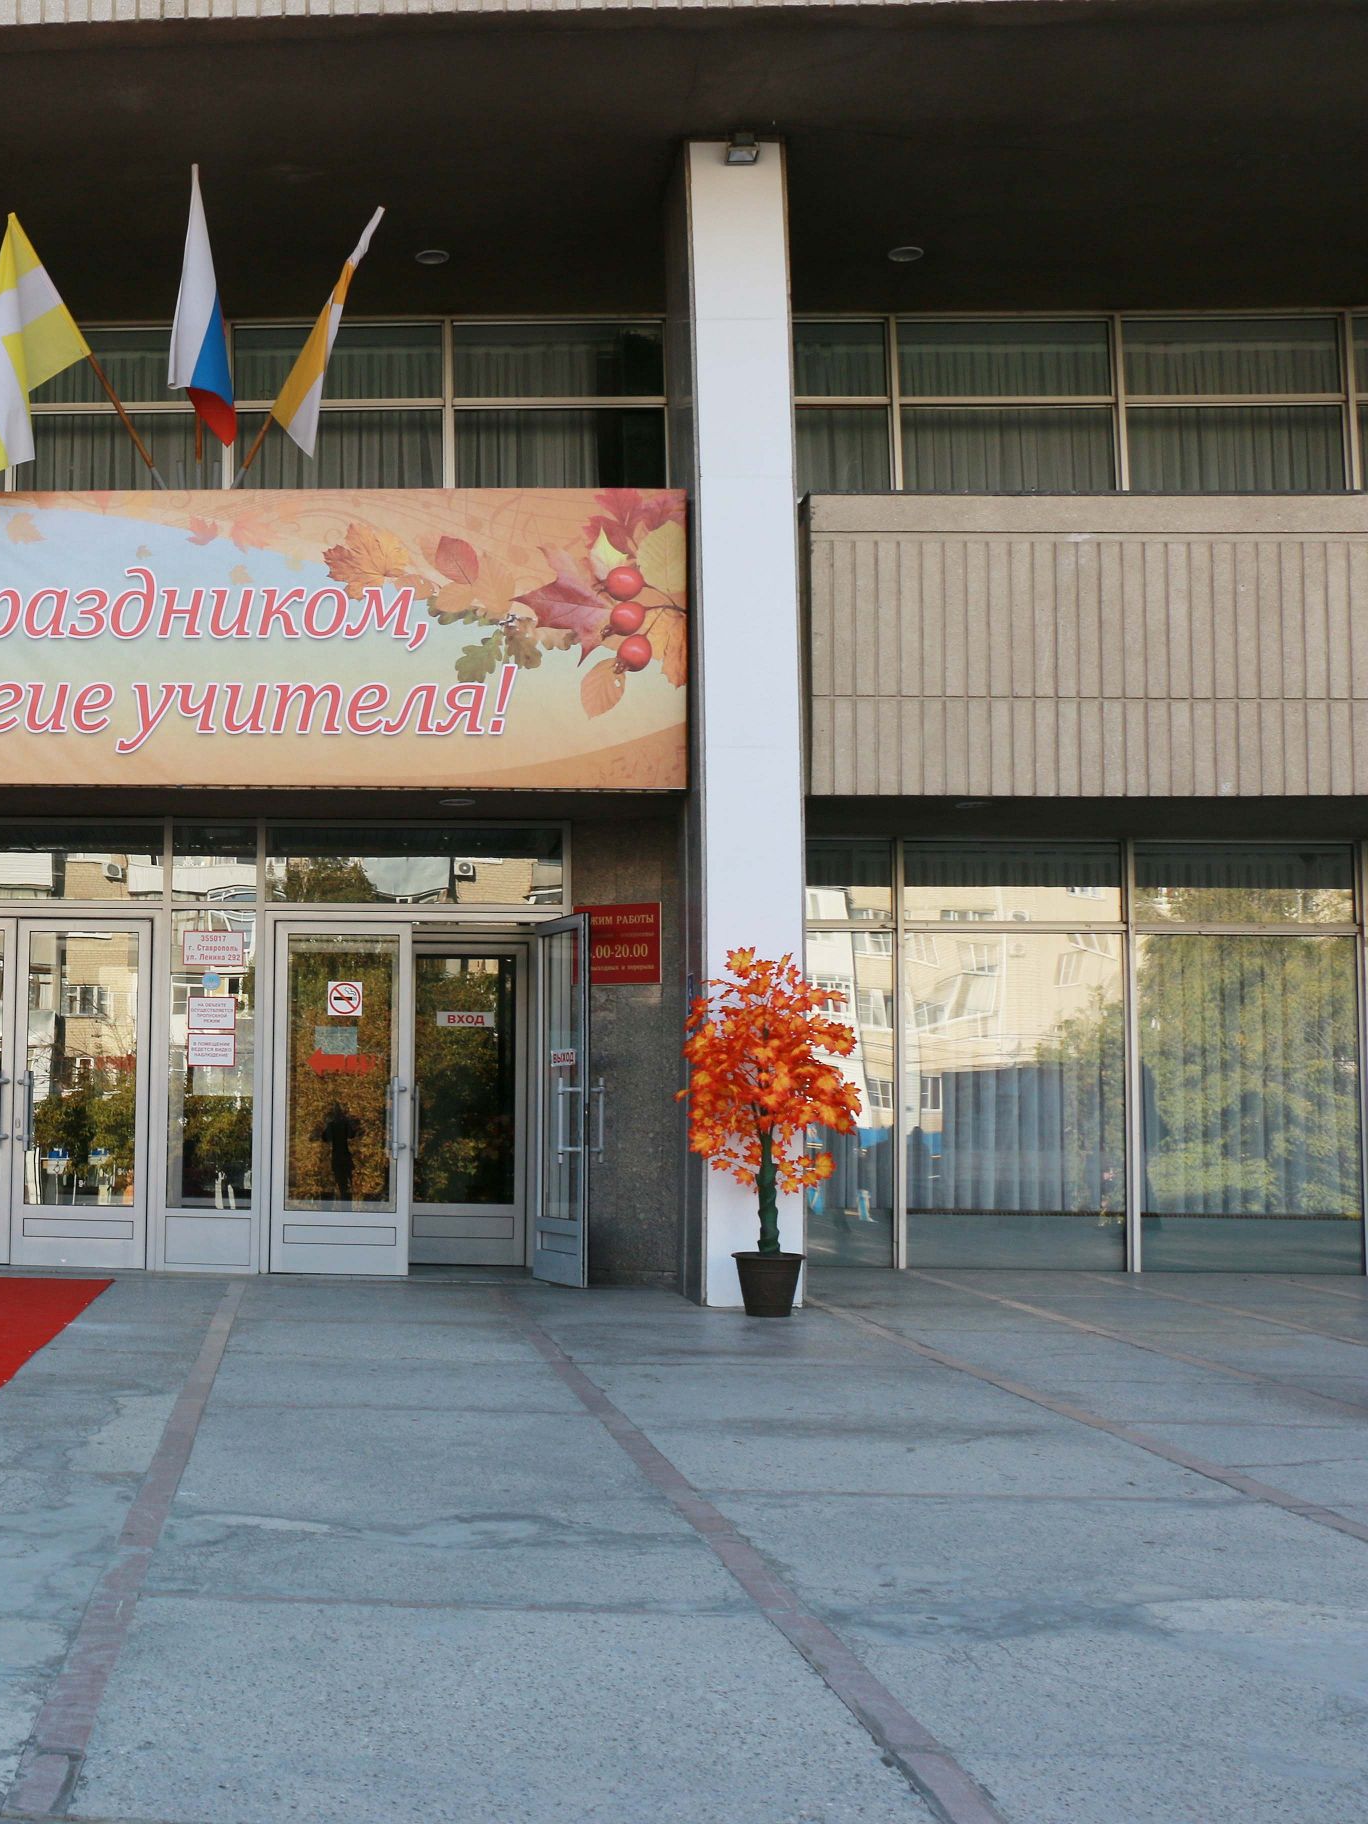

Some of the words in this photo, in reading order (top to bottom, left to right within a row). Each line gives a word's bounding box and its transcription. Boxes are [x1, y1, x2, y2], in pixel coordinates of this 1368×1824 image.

[116, 664, 518, 754] учителя!
[590, 916, 613, 926] ЖИМ
[616, 914, 655, 924] РАБОТЫ
[197, 944, 238, 952] Ставрополь
[591, 943, 649, 959] .00-20.00
[199, 953, 226, 961] Ленина
[227, 953, 241, 961] 292
[447, 1015, 485, 1025] ВХОД
[552, 1051, 575, 1064] ВЫХОД
